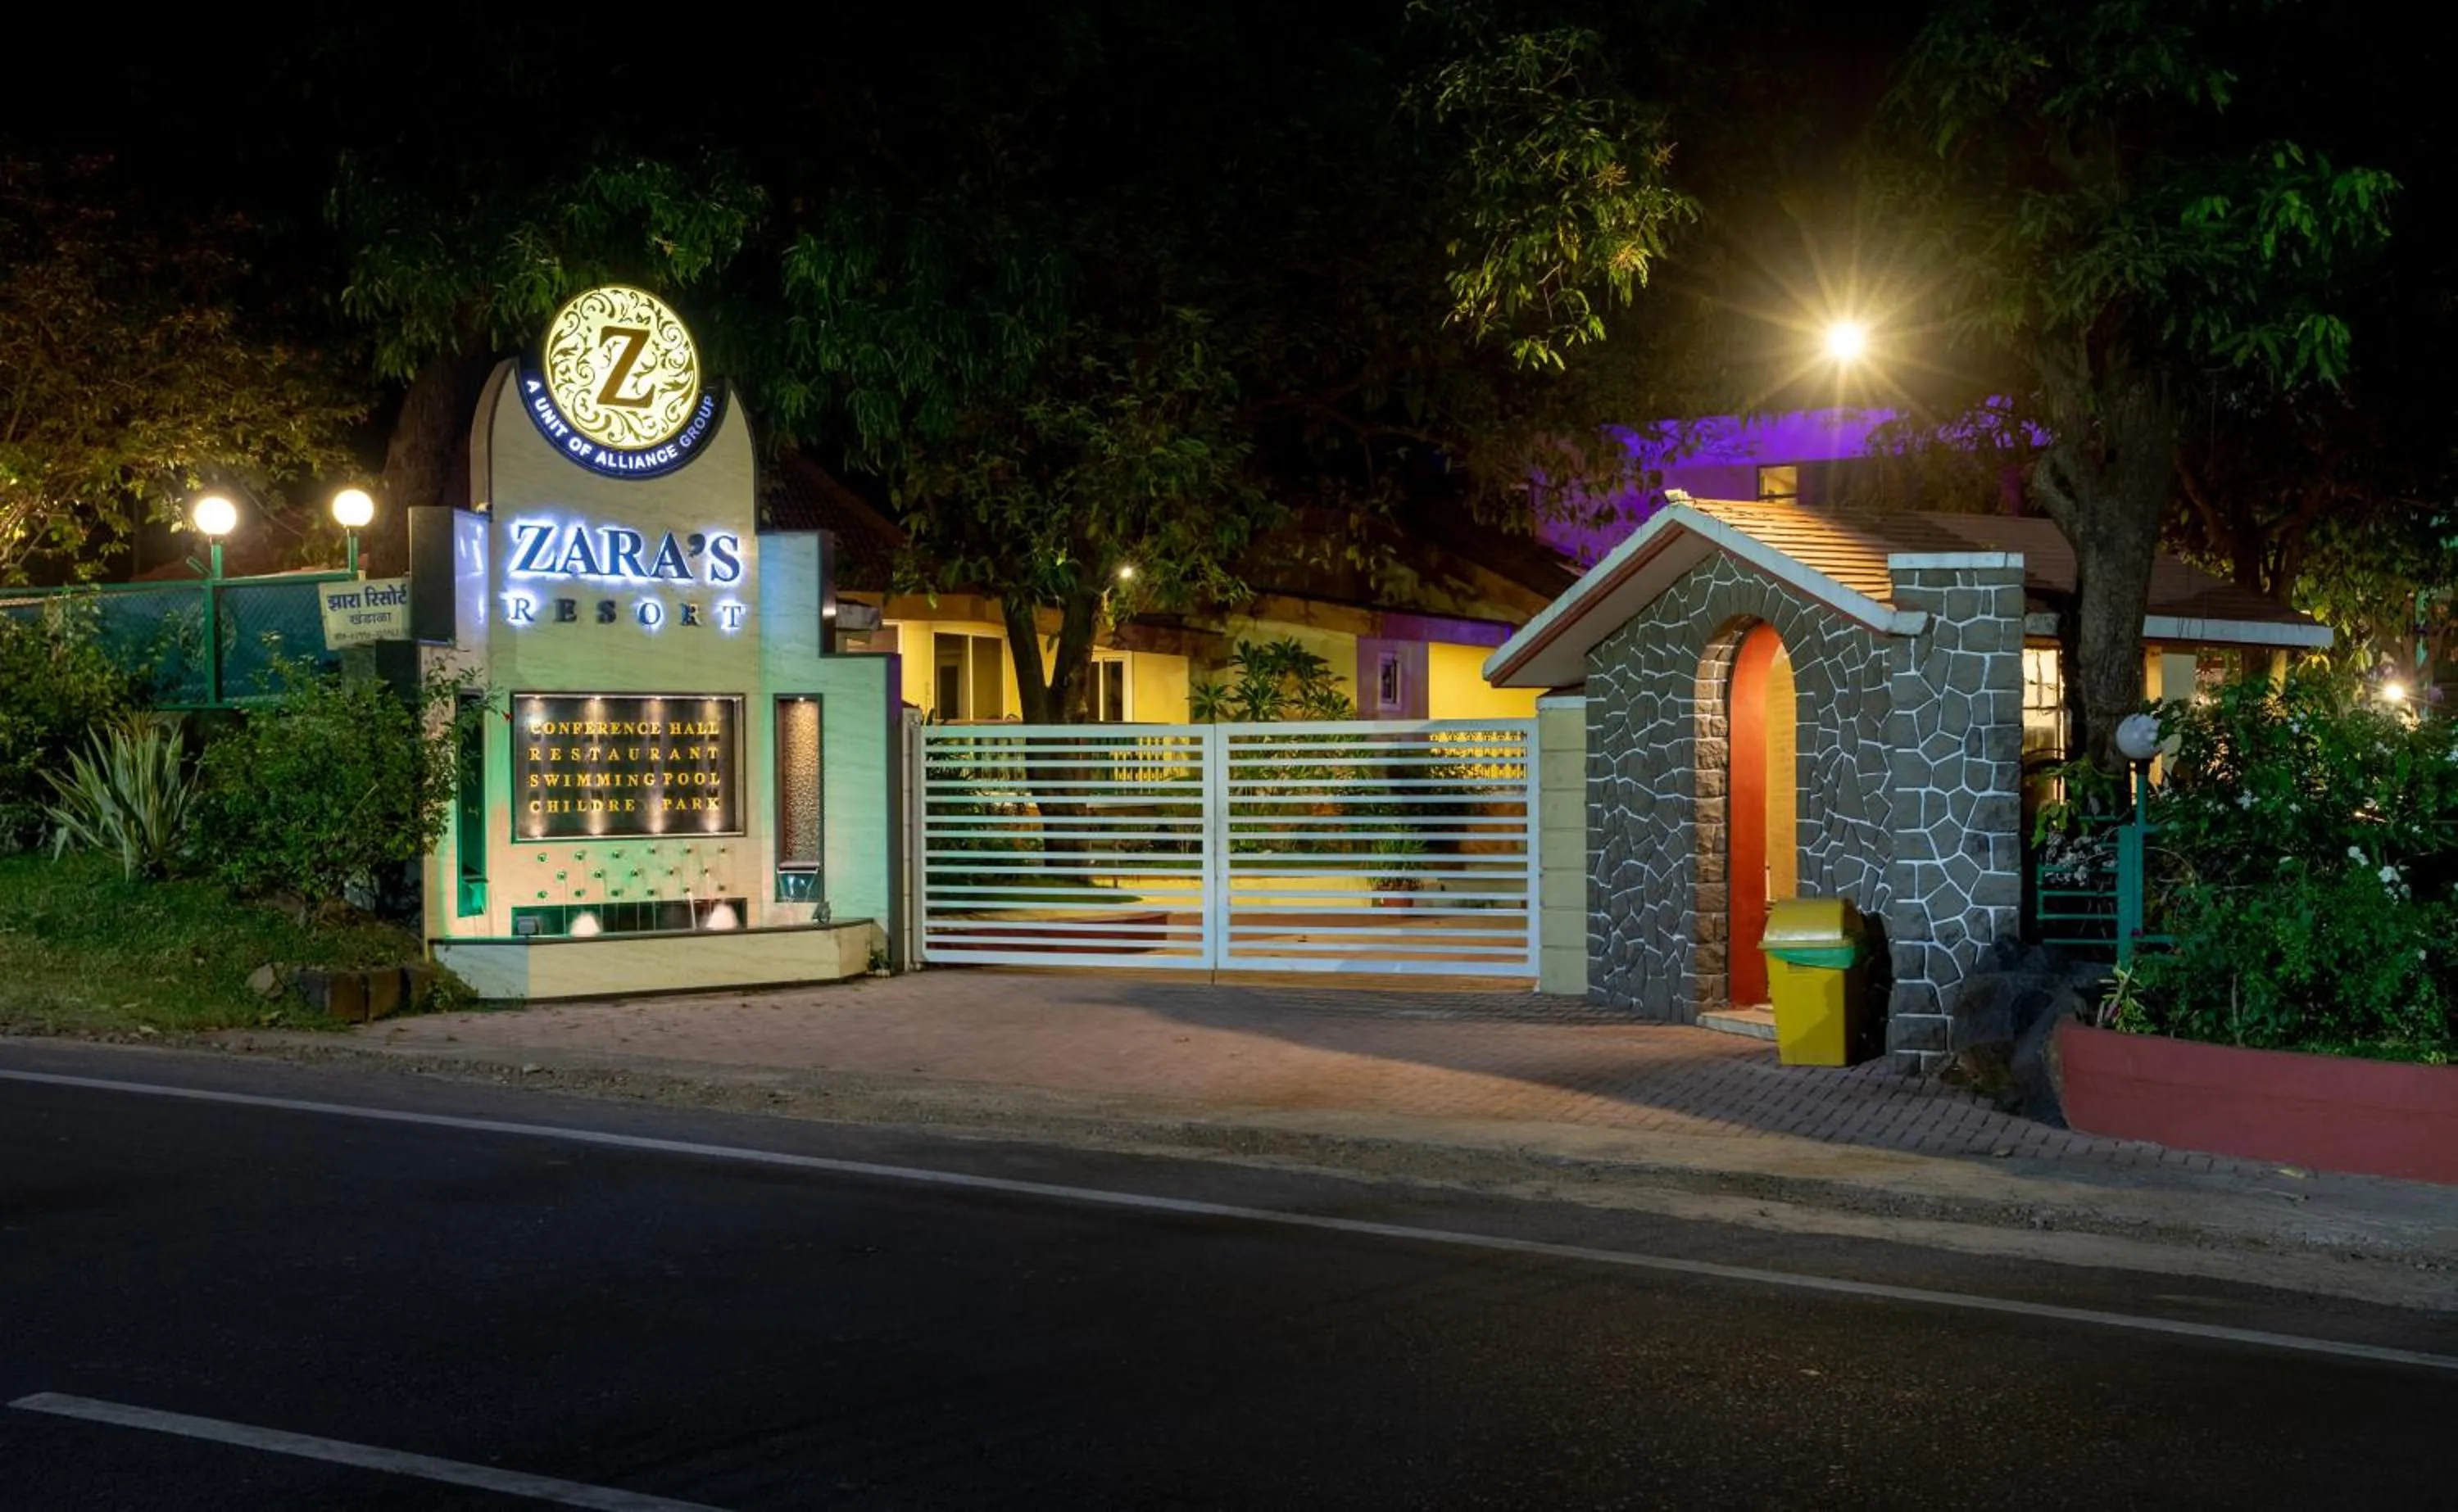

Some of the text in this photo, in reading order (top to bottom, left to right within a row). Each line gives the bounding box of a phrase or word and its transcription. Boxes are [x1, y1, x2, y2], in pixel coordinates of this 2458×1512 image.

[596, 325, 655, 408] Z
[527, 379, 714, 469] A UNIT OF ALLIANCE GROUP
[328, 584, 407, 611] झारा रिसोर्ट
[511, 598, 742, 628] RESORT
[530, 721, 720, 736] CONFERENCE HALL
[529, 746, 719, 762] RESTAURANT
[529, 772, 720, 788] SWIMMING POOL
[662, 798, 720, 811] PARK
